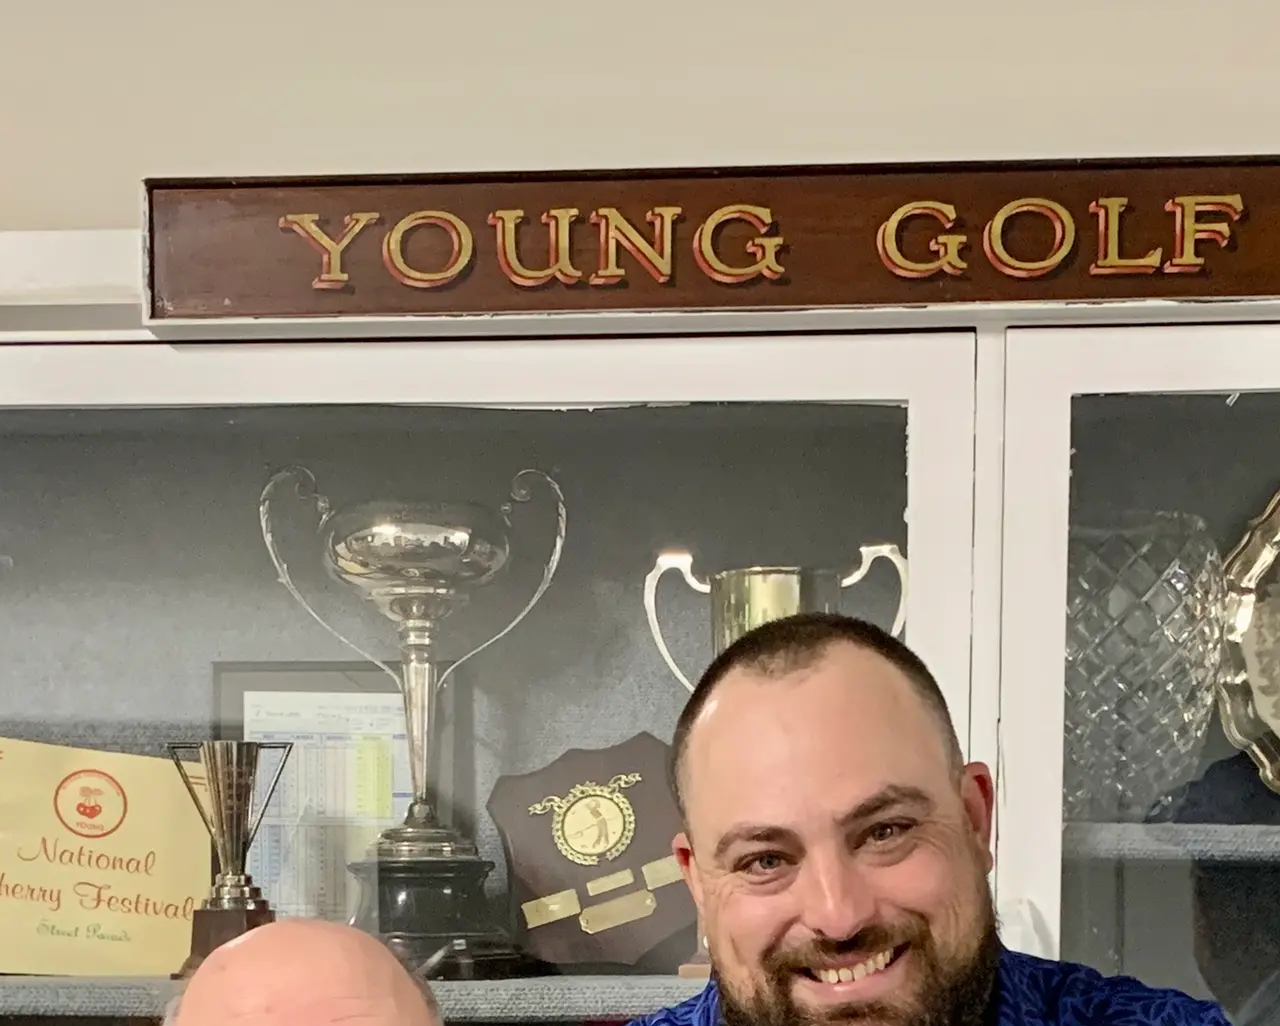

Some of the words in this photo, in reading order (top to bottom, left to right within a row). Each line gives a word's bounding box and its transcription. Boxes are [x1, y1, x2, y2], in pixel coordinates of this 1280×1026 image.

[278, 203, 788, 289] YOUNG
[876, 193, 1244, 279] GOLF
[17, 836, 156, 876] National
[73, 881, 194, 921] Festival
